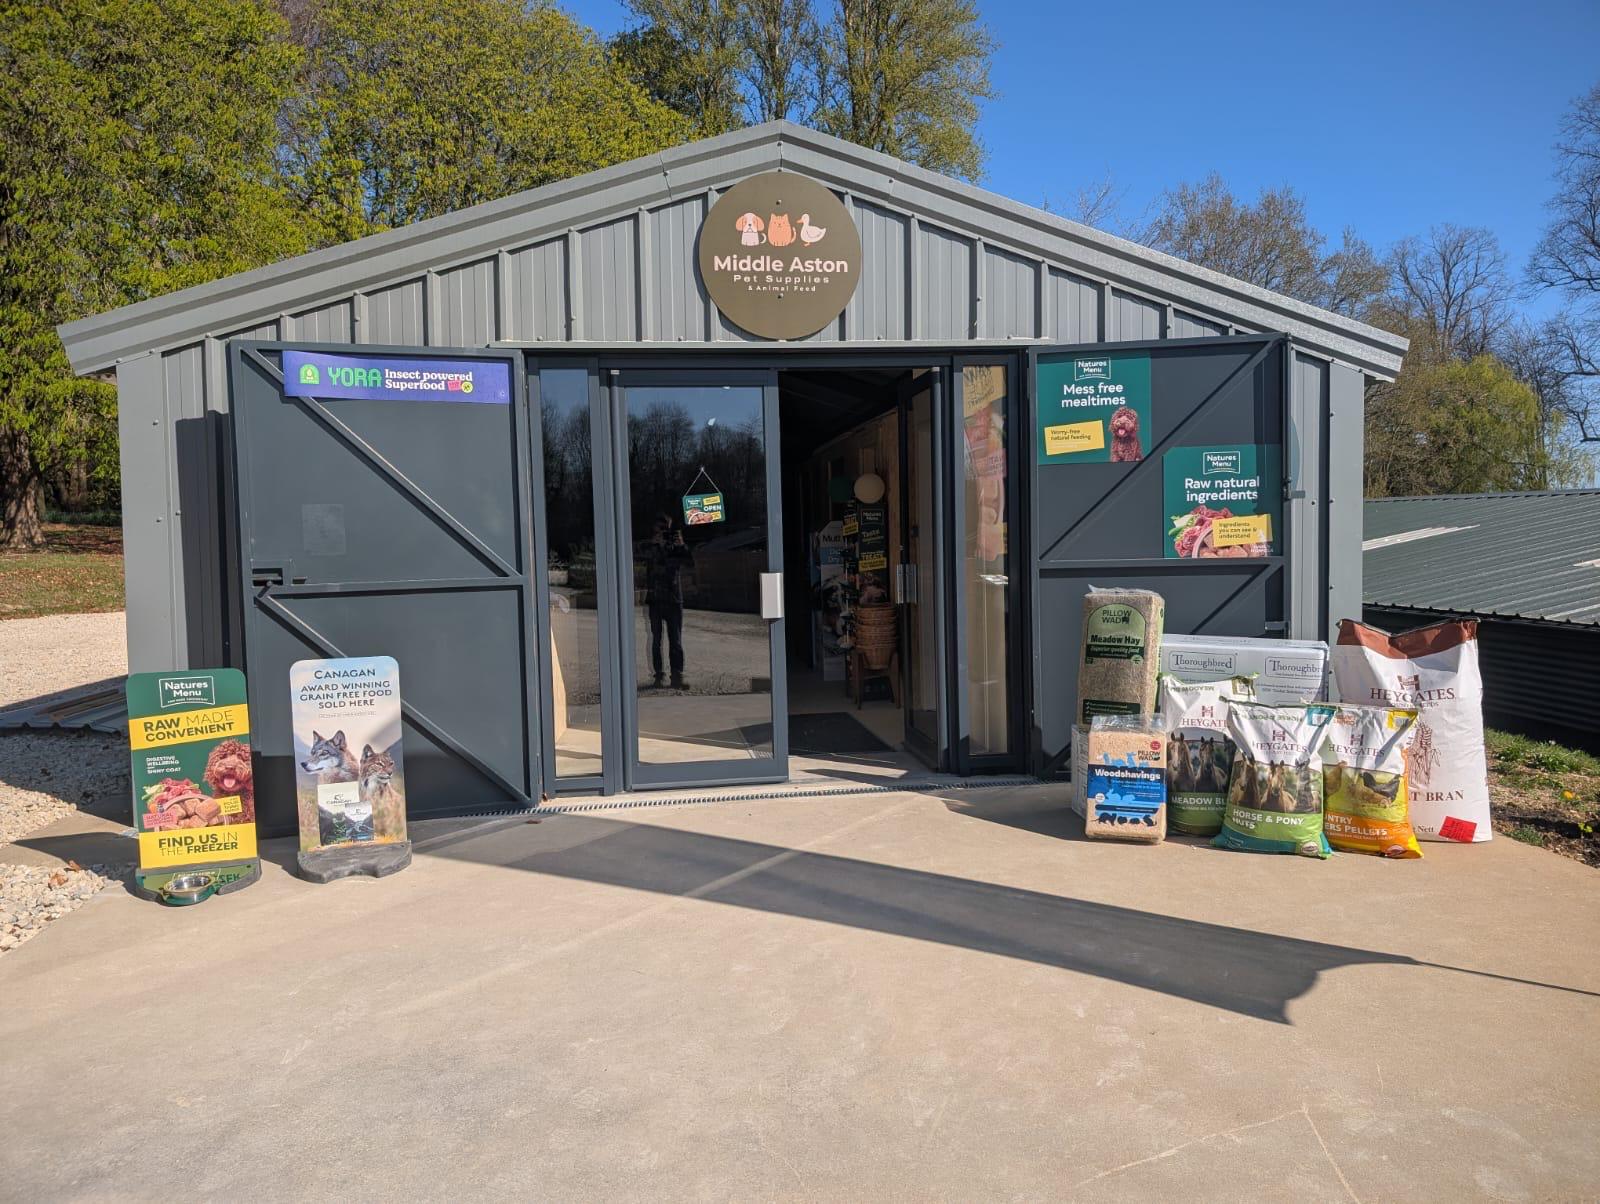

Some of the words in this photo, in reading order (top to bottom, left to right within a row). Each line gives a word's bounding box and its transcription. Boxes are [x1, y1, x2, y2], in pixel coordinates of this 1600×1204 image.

[713, 255, 784, 272] Middle
[788, 256, 849, 273] Aston
[733, 274, 757, 283] Pet
[766, 275, 830, 285] Supplies
[1078, 360, 1107, 368] Natures
[327, 366, 383, 388] YORA
[384, 368, 421, 380] Insect
[422, 371, 473, 382] powered
[384, 379, 445, 391] Superfood
[1063, 383, 1095, 395] Mess
[1098, 382, 1124, 393] free
[1061, 395, 1126, 408] mealtimes
[1206, 454, 1237, 462] Natures
[1185, 477, 1211, 489] Raw
[1215, 476, 1260, 488] natural
[1186, 489, 1258, 504] ingredients
[1102, 609, 1132, 617] PILLOW
[1101, 616, 1122, 624] WAD
[1090, 634, 1123, 643] Meadow
[1124, 636, 1141, 645] Hay
[1172, 654, 1233, 669] Thoroughbred
[314, 668, 376, 679] CANAGAN
[164, 681, 208, 690] Natures
[300, 683, 338, 693] AWARD
[341, 680, 390, 690] WINNING
[172, 689, 202, 698] Menu
[300, 692, 334, 702] GRAIN
[336, 691, 360, 699] FREE
[363, 689, 392, 697] FOOD
[1370, 687, 1455, 703] HEYGATES
[318, 700, 346, 709] SOLD
[349, 698, 375, 707] HERE
[143, 717, 181, 733] RAW
[186, 709, 235, 727] MADE
[145, 721, 235, 742] CONVENIENT
[1252, 740, 1308, 753] HEYGATES
[1328, 743, 1385, 757] HEYGATES
[1095, 768, 1161, 782] Woodshavings
[1171, 796, 1213, 805] MEADOW
[1409, 791, 1420, 801] T
[1426, 789, 1465, 802] BRAN
[1232, 808, 1263, 822] HORSE
[1265, 815, 1273, 823] &
[1276, 816, 1305, 825] PONY
[1344, 826, 1388, 836] PELLETS
[1417, 825, 1434, 833] Nett
[158, 835, 195, 849] FIND
[198, 833, 218, 845] US
[223, 831, 238, 843] IN
[159, 846, 184, 857] THE
[187, 841, 238, 854] FREEZER
